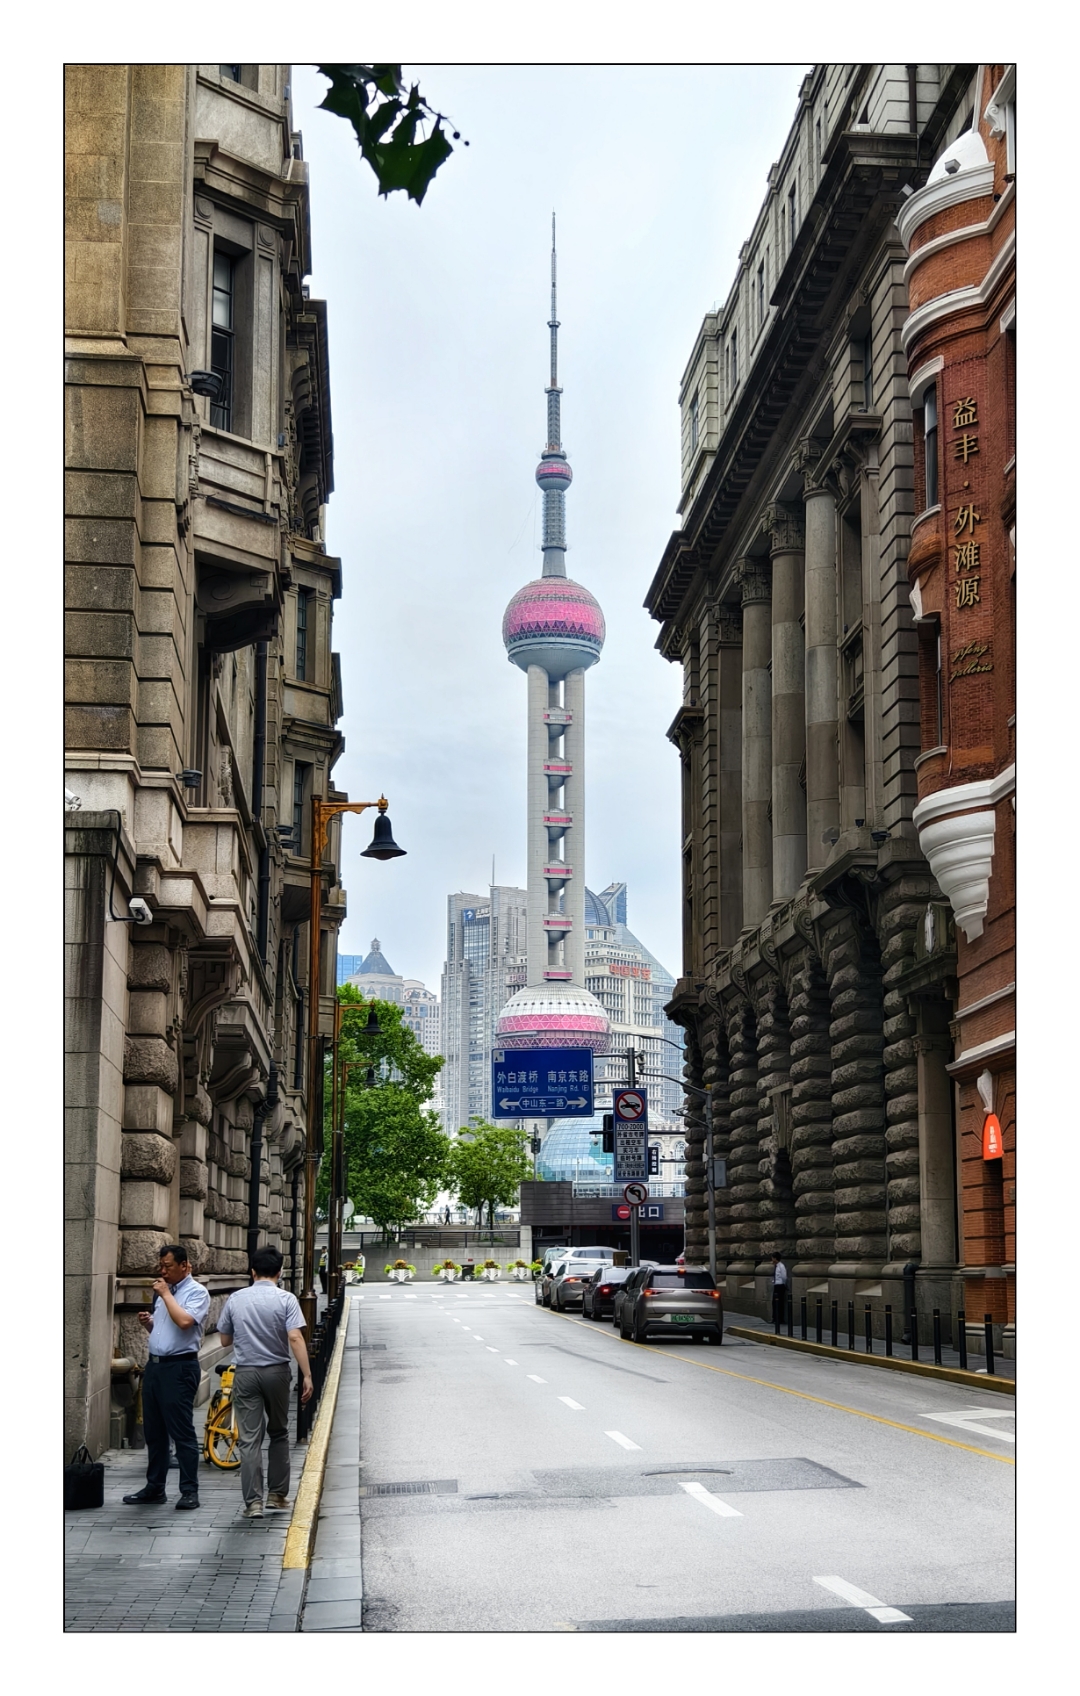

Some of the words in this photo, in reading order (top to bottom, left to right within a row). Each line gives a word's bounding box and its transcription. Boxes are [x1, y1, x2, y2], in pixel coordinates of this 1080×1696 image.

[953, 397, 980, 608] 益丰·外滩源
[948, 658, 993, 684] galleria
[497, 1071, 538, 1084] 外白渡桥
[547, 1070, 589, 1083] 南京东路
[522, 1085, 539, 1093] Bridge
[547, 1085, 567, 1093] Nanjing
[522, 1098, 564, 1108] 中山东一路
